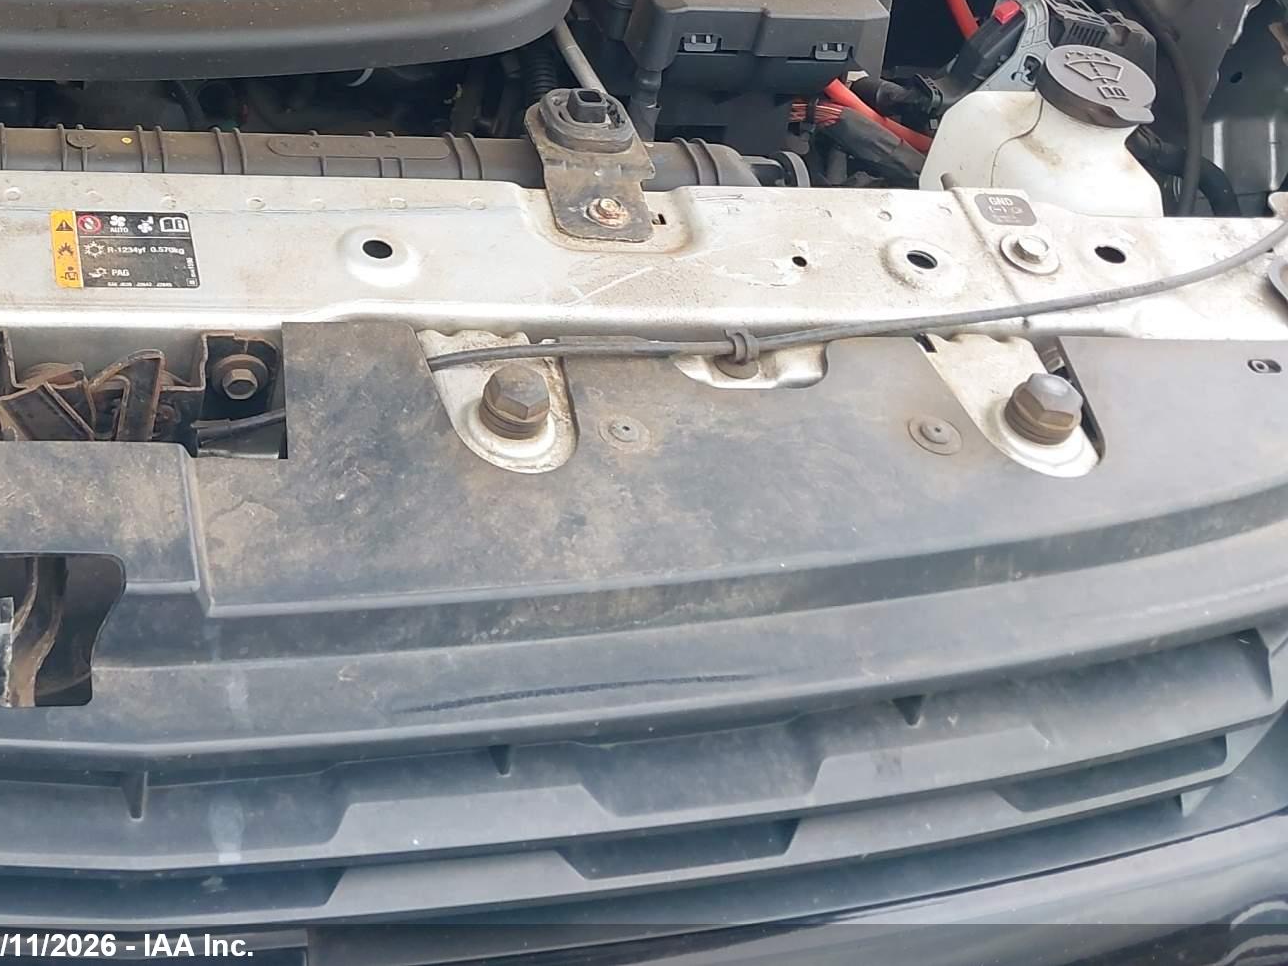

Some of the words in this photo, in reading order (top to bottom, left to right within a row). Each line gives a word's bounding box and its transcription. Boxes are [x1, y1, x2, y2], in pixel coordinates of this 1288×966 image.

[988, 196, 1014, 206] GND
[110, 226, 129, 234] AUTO
[111, 268, 130, 277] PAG
